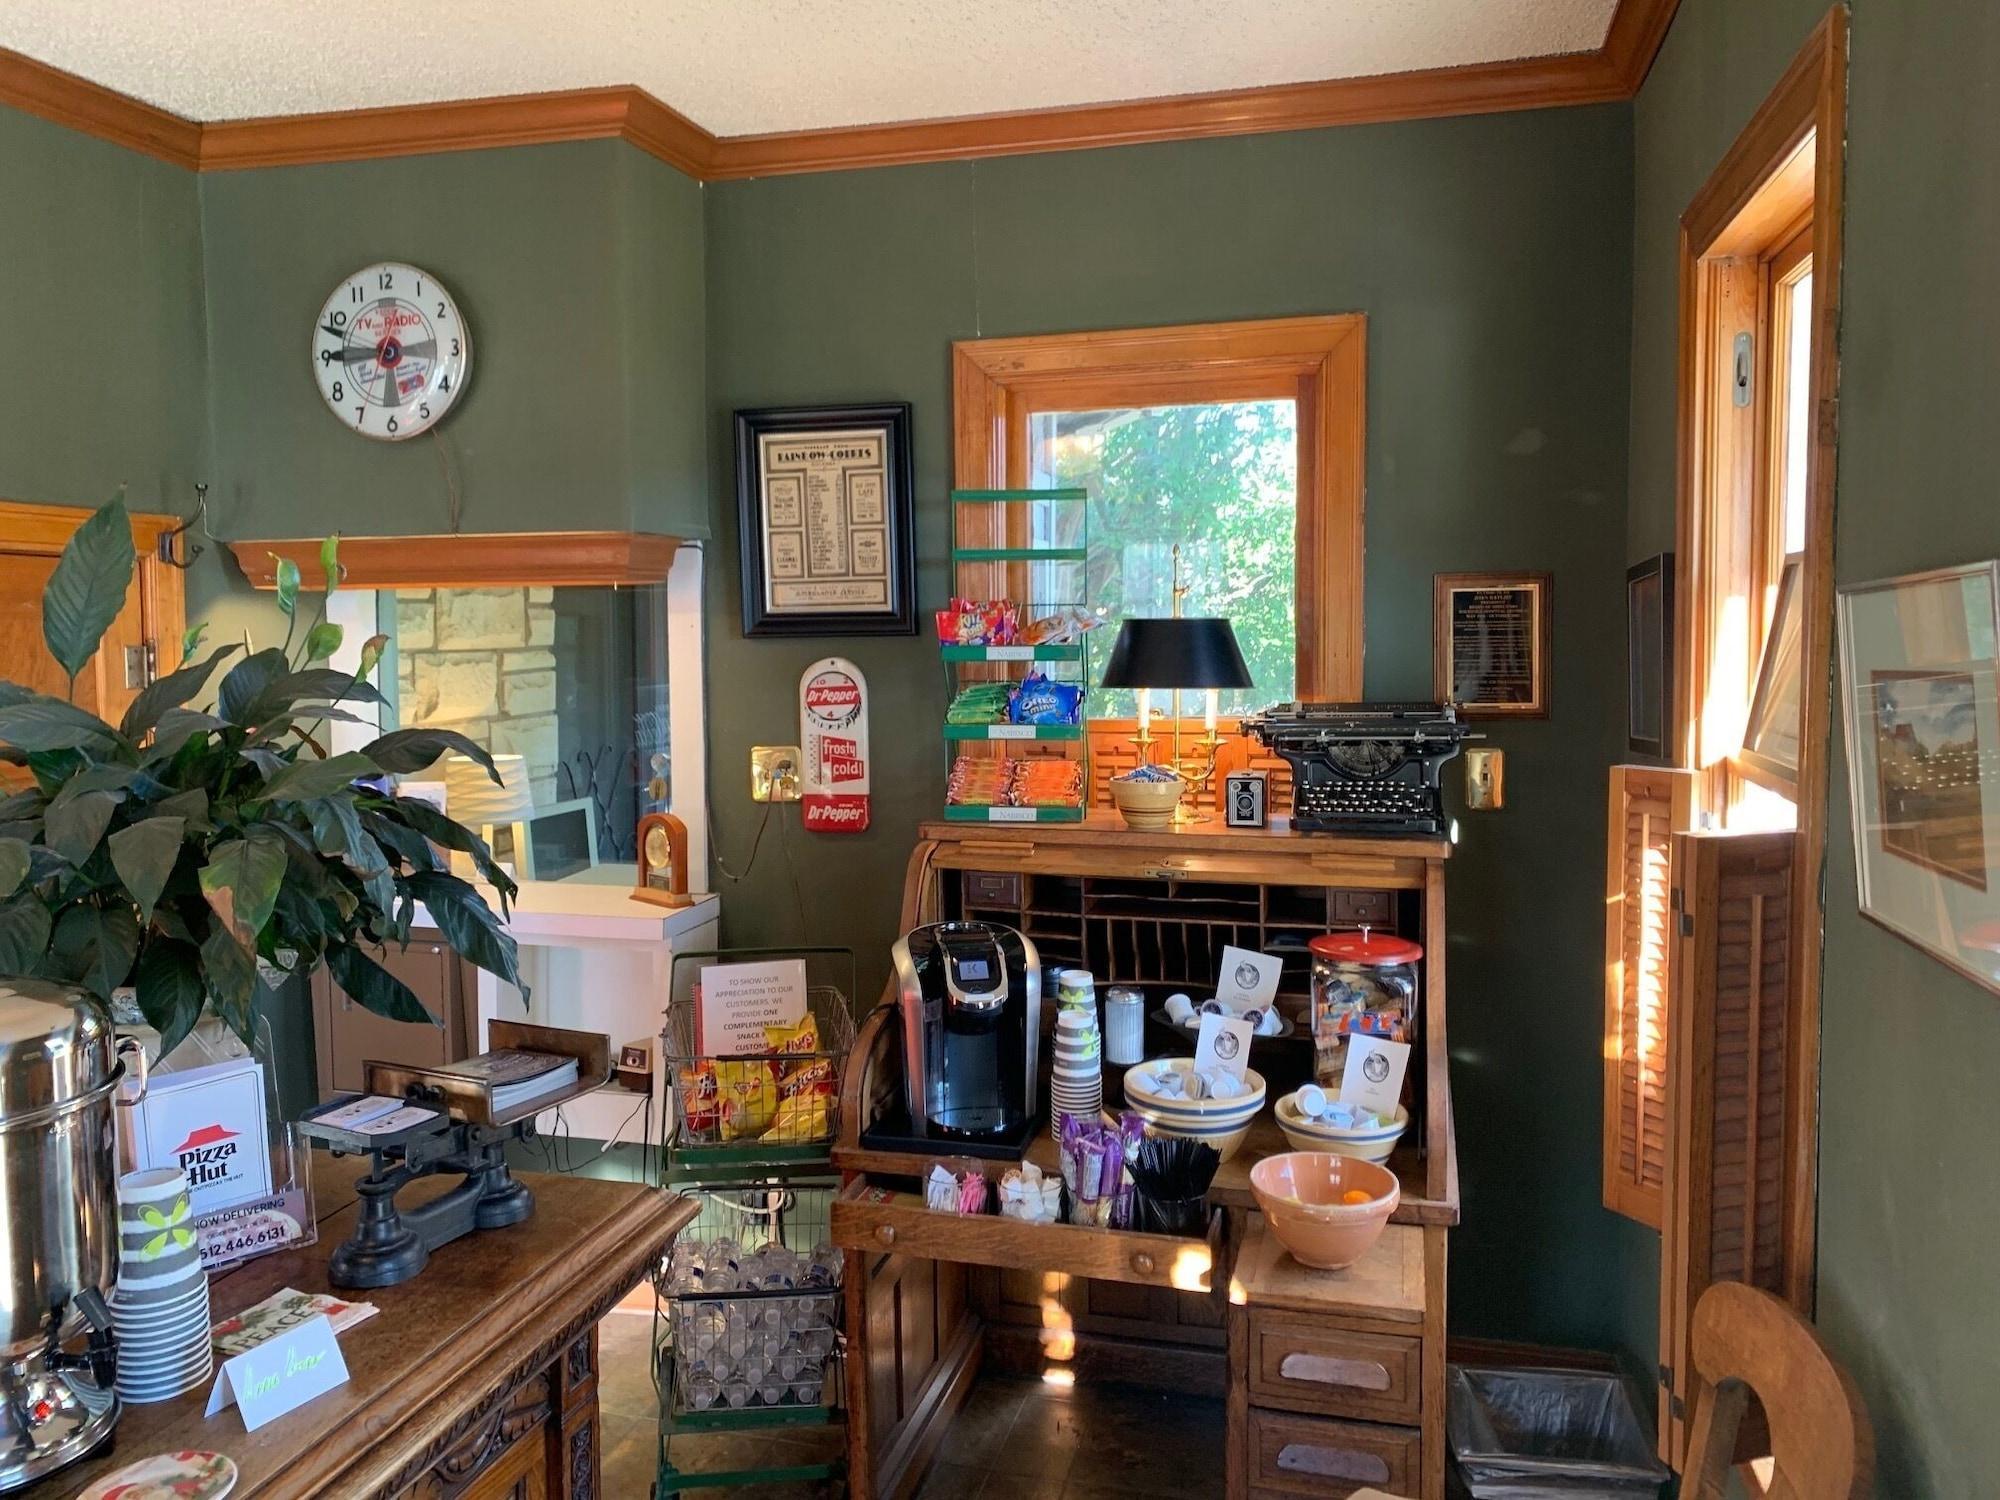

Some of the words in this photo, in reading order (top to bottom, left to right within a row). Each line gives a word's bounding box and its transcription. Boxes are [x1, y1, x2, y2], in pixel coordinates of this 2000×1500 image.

[379, 273, 393, 290] 12
[416, 281, 421, 297] 1
[352, 286, 363, 303] 11
[437, 302, 446, 318] 2
[330, 311, 346, 327] 10
[357, 319, 373, 330] TV
[384, 314, 421, 328] RADIO
[451, 338, 459, 357] 3
[321, 350, 331, 367] 9
[332, 382, 343, 401] 8
[439, 375, 451, 393] 4
[355, 406, 365, 424] 7
[419, 402, 430, 419] 5
[387, 415, 398, 432] 6
[819, 687, 858, 703] Pepper
[827, 710, 834, 718] 4
[823, 740, 856, 758] frosty
[832, 762, 863, 778] cold!
[822, 804, 864, 822] Pepper
[740, 976, 762, 985] SHOW
[763, 975, 779, 983] OUR
[715, 987, 766, 998] APPRECIATION
[767, 986, 777, 994] TO
[778, 985, 794, 993] OUR
[772, 997, 783, 1006] WE
[731, 1009, 762, 1019] PROVIDE
[763, 1008, 779, 1017] ONE
[723, 1018, 788, 1031] COMPLEMENTARY
[736, 1032, 761, 1041] SNACK
[179, 1143, 238, 1174] Pizza
[186, 1161, 229, 1187] Hut
[224, 1198, 286, 1223] DELIVERING
[233, 1309, 316, 1349] PEACE
